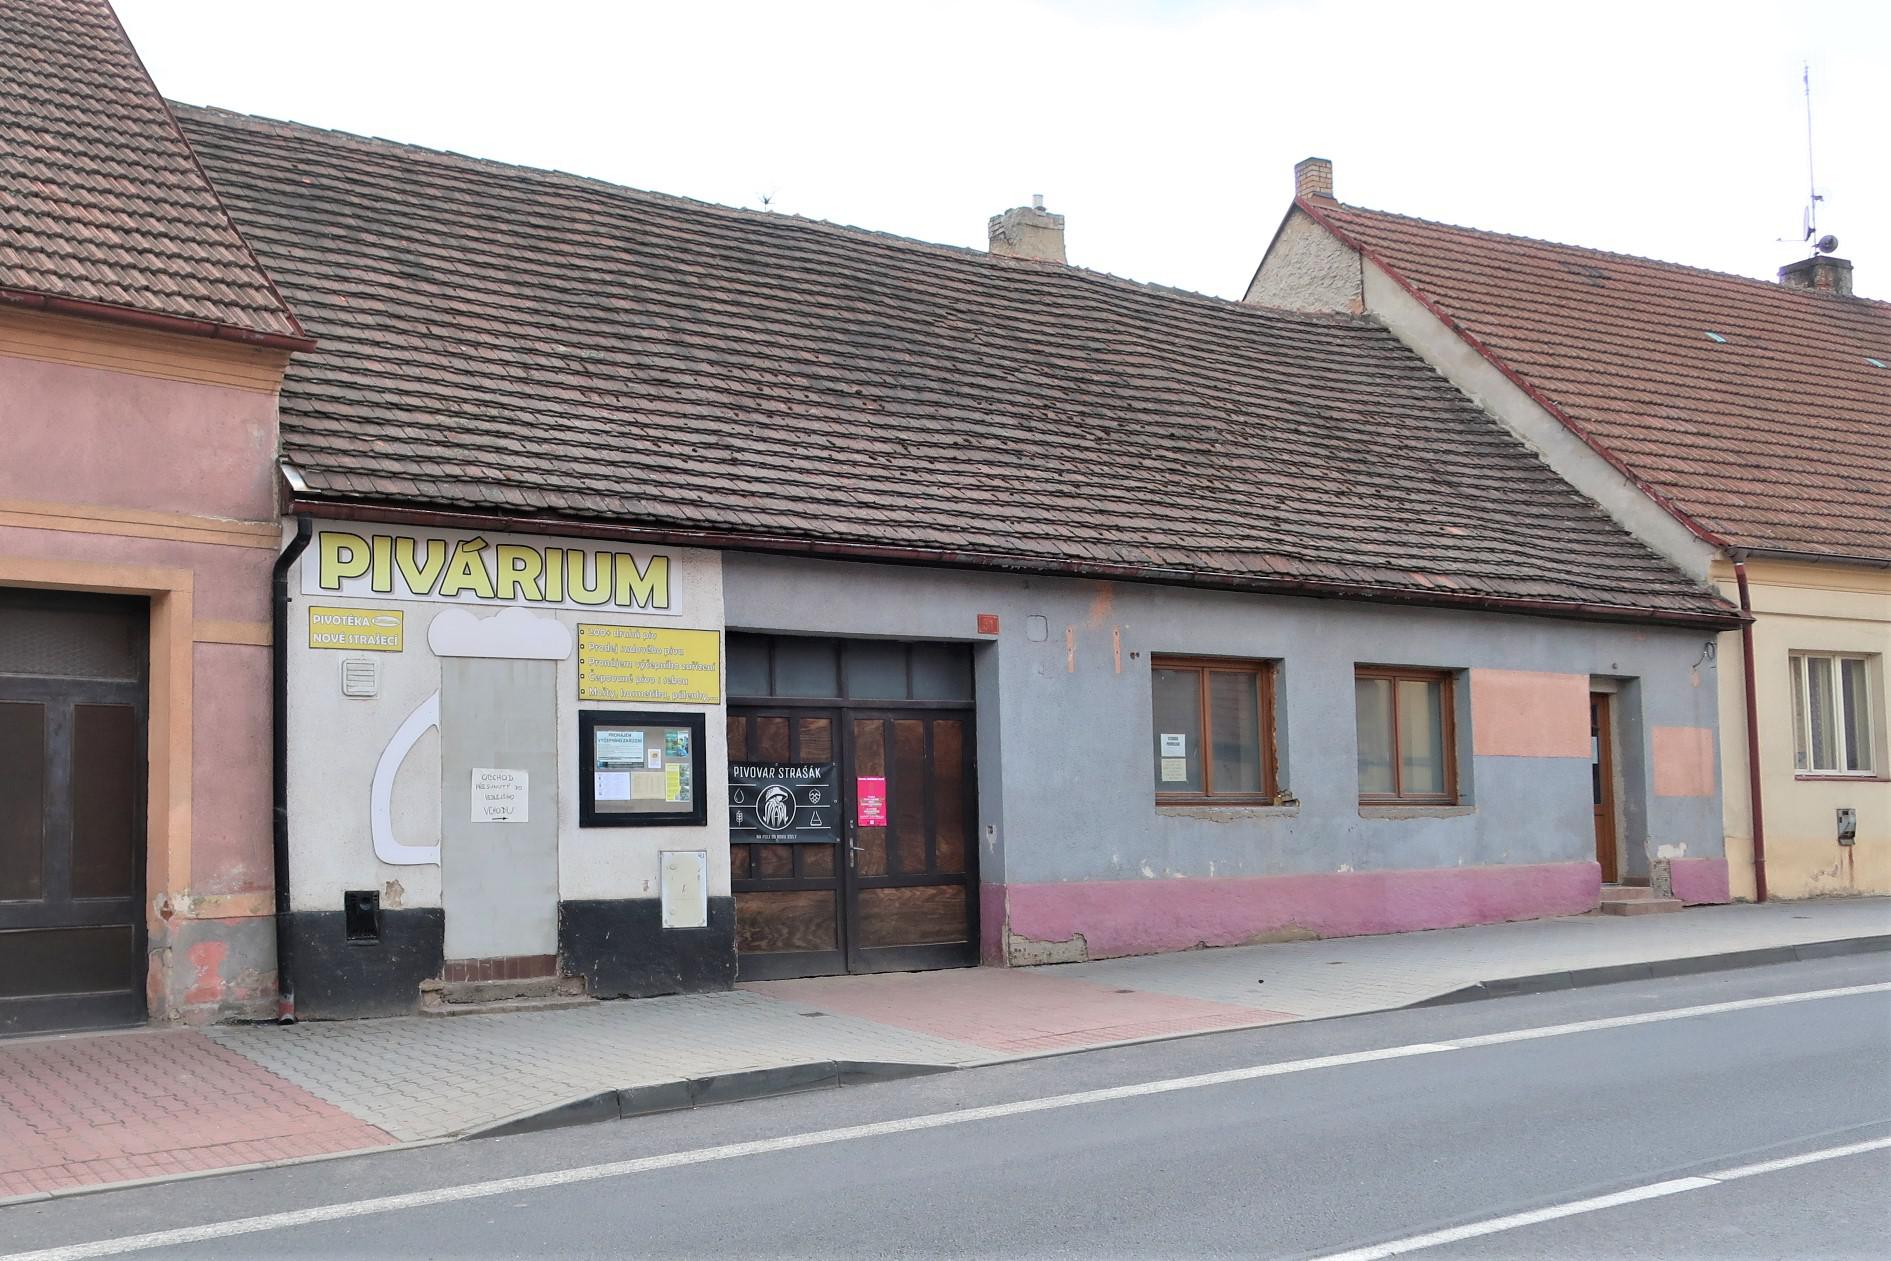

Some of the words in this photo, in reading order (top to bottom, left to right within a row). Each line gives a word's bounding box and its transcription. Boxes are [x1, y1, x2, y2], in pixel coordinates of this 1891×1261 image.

[318, 531, 671, 610] PIVÁRIUM
[313, 614, 370, 627] PIVOTÉKA
[313, 631, 345, 643] NOVÉ
[348, 632, 398, 646] STRAŠECÍ
[733, 766, 775, 778] PIVOVAR
[778, 764, 821, 779] STRAŠÁK
